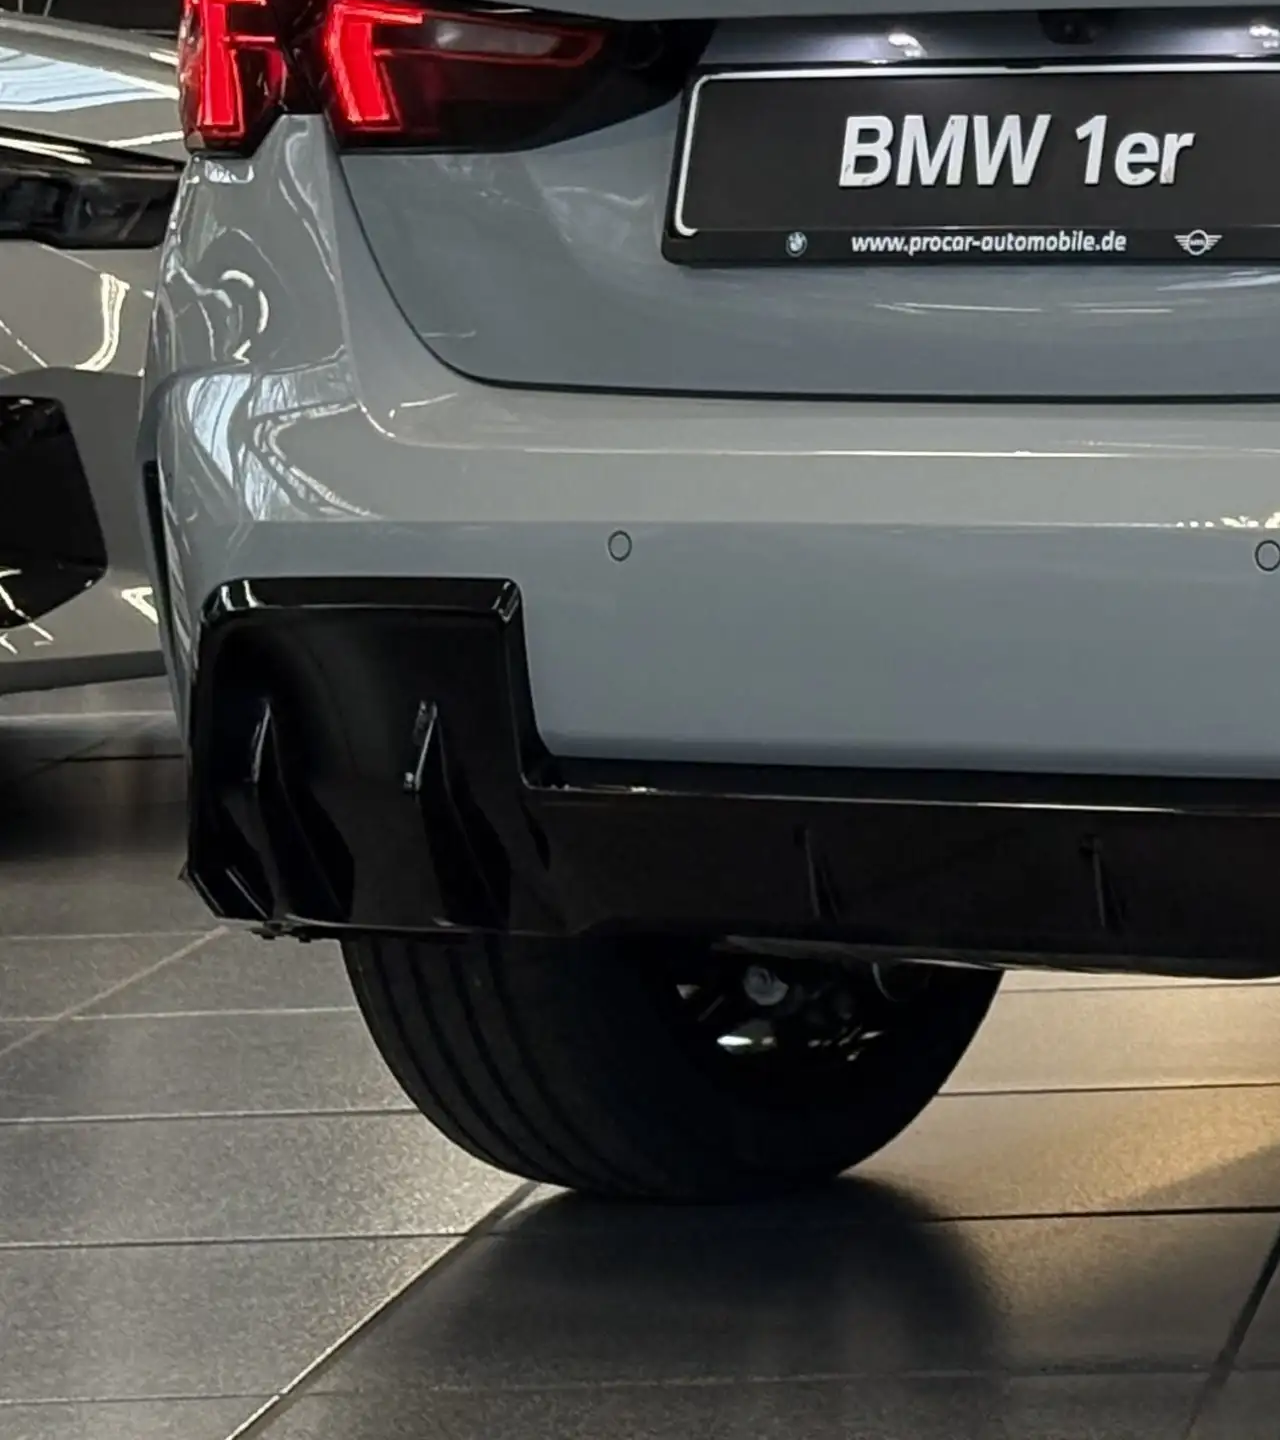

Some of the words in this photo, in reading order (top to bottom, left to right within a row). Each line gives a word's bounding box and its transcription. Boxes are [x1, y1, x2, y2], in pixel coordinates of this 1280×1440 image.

[838, 113, 1052, 188] BMW
[1074, 114, 1196, 187] 1er
[850, 229, 1128, 257] www.procar-automobile.de
